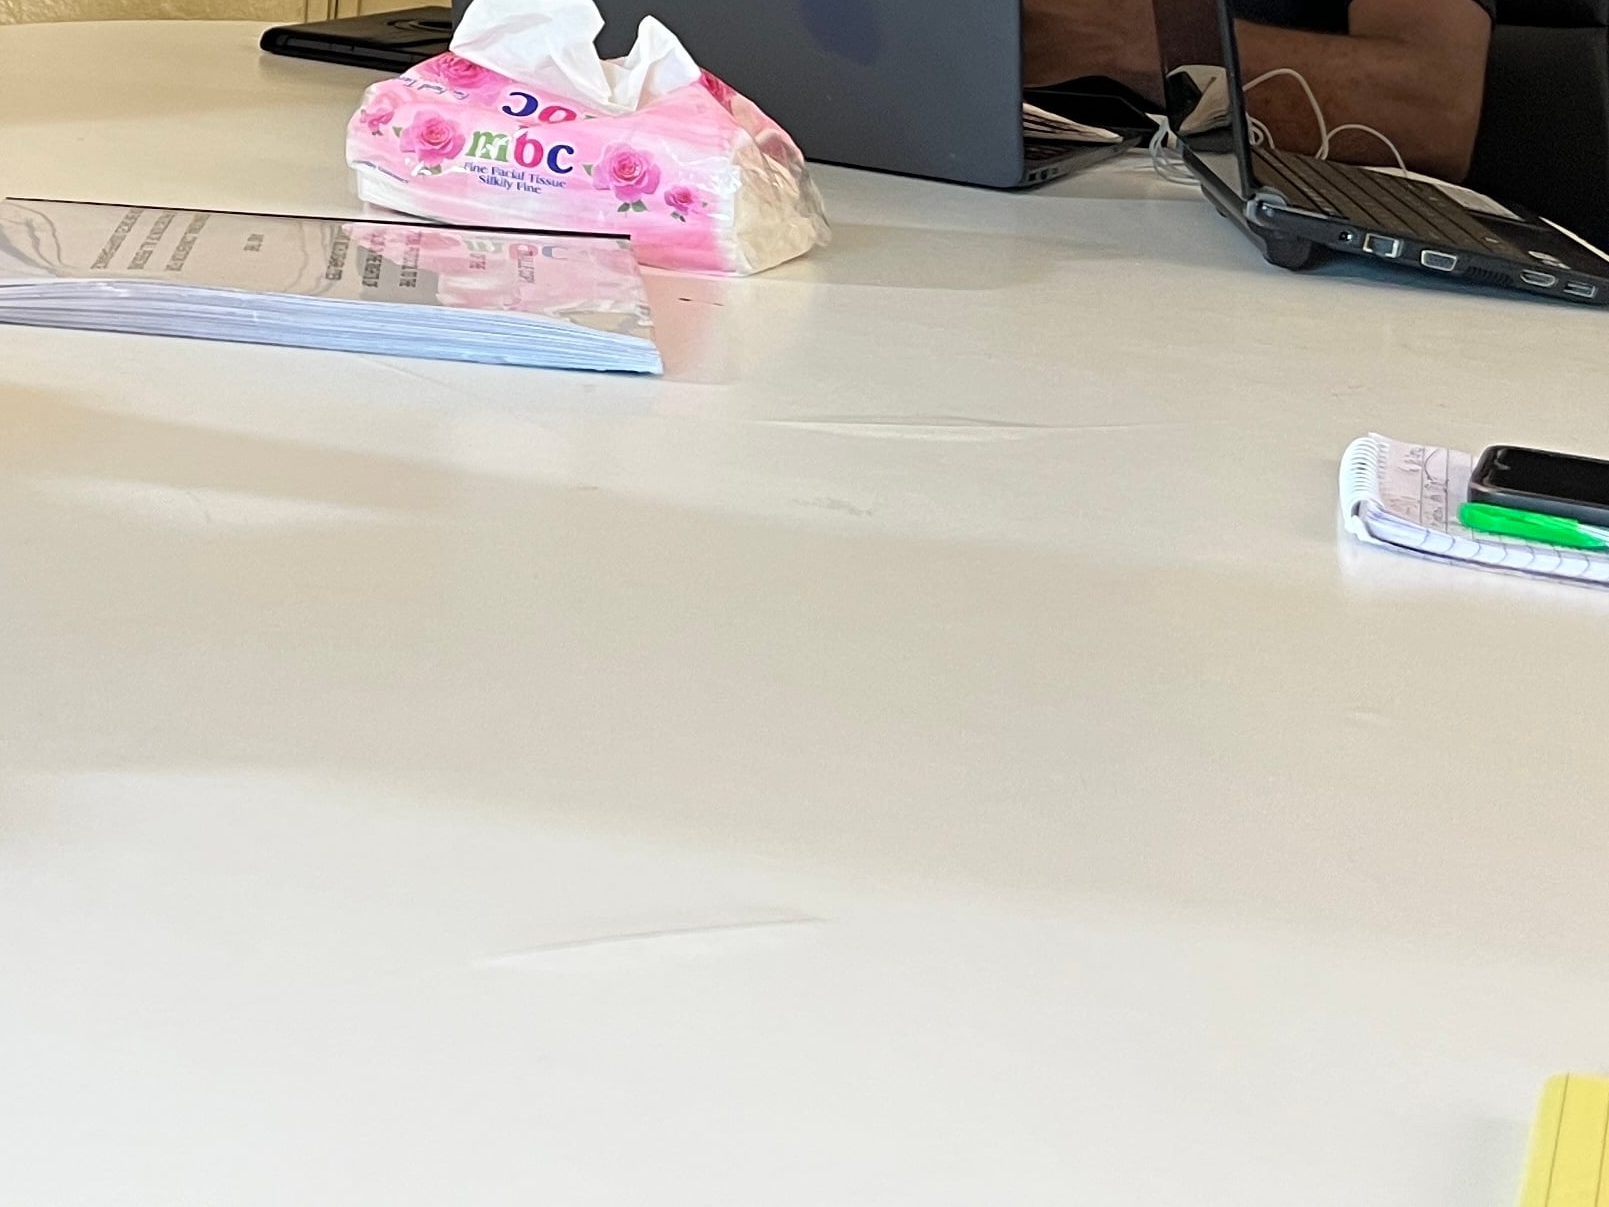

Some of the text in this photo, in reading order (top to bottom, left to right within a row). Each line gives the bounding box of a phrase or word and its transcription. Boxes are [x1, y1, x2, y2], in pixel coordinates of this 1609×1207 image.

[465, 128, 575, 175] mbc
[463, 161, 567, 189] Fine Facial Tissue
[516, 181, 542, 195] Fine
